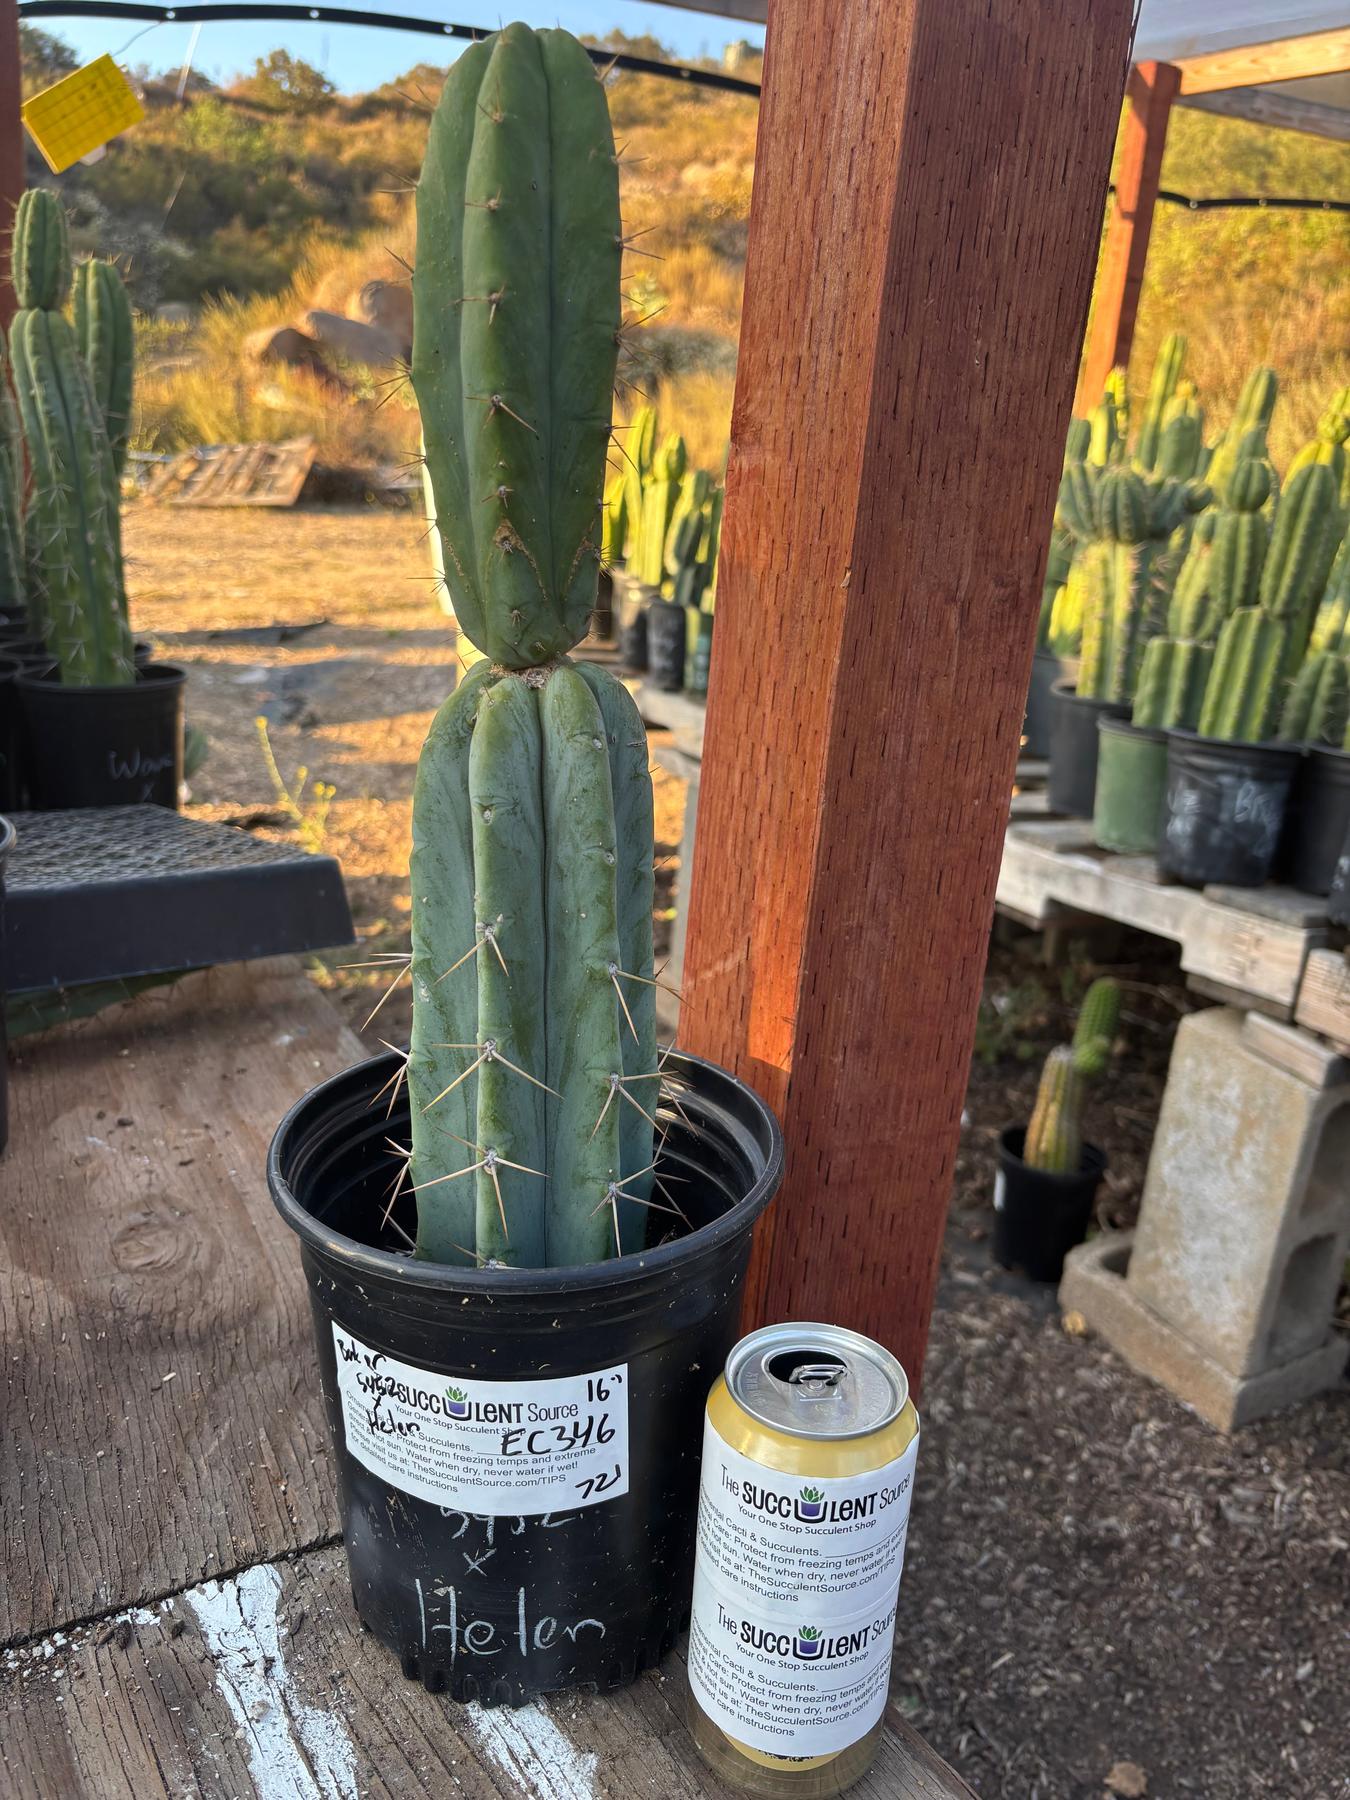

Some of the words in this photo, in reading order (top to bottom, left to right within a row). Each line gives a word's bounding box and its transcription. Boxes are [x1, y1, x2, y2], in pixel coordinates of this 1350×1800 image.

[395, 1404, 412, 1416] Your
[415, 1412, 431, 1424] One
[433, 1417, 453, 1430] Stop
[455, 1421, 500, 1435] Succulent
[502, 1427, 526, 1436] Shp
[528, 1403, 578, 1421] Source
[397, 1434, 430, 1451] Protect
[429, 1447, 450, 1458] from
[453, 1452, 493, 1466] freezing
[497, 1458, 528, 1466] temps
[532, 1456, 551, 1464] and
[554, 1448, 595, 1461] extreme
[419, 1432, 473, 1452] Succulents.
[501, 1414, 615, 1456] EC346
[360, 1442, 386, 1464] detailed
[388, 1460, 405, 1474] care
[407, 1471, 458, 1492] instructions
[372, 1442, 386, 1454] visit
[388, 1451, 397, 1460] us
[399, 1455, 409, 1466] at:
[411, 1460, 566, 1487] TheSucculentSource.com/TIPS
[386, 1441, 403, 1453] sun.
[406, 1448, 432, 1464] Water
[434, 1460, 459, 1471] when
[463, 1466, 481, 1476] dry,
[516, 1468, 545, 1476] water
[548, 1465, 555, 1473] if
[557, 1461, 578, 1472] wet!
[721, 1464, 739, 1496] The
[880, 1473, 910, 1509] Source
[726, 1518, 747, 1537] Cacti
[750, 1533, 757, 1542] &
[760, 1537, 822, 1556] Succulents.
[738, 1503, 756, 1519] Your
[759, 1515, 778, 1528] One
[780, 1522, 802, 1534] Stop
[804, 1526, 852, 1535] Succulent
[855, 1520, 876, 1531] Shop
[712, 1528, 721, 1545] hot
[723, 1541, 739, 1558] sun.
[743, 1553, 771, 1573] Water
[775, 1568, 803, 1579] when
[807, 1572, 826, 1582] dry,
[831, 1568, 859, 1580] never
[861, 1556, 885, 1573] water
[713, 1518, 731, 1540] Care:
[734, 1536, 767, 1559] Protect
[771, 1553, 794, 1565] from
[799, 1559, 842, 1569] freezing
[845, 1552, 874, 1566] temps
[876, 1539, 890, 1555] and
[721, 1566, 738, 1582] care
[740, 1577, 799, 1601] instructions
[722, 1554, 731, 1565] us
[734, 1562, 745, 1573] at:
[748, 1555, 895, 1592] TheSucculentSource.com/TIPS
[415, 1579, 606, 1671] Helen
[718, 1602, 737, 1635] The
[723, 1654, 745, 1674] Cacti
[747, 1670, 754, 1679] &
[757, 1674, 818, 1691] Succulents.
[736, 1641, 754, 1658] Your
[757, 1653, 776, 1666] One
[778, 1660, 800, 1671] Stop
[803, 1660, 848, 1671] Succulent
[849, 1651, 869, 1665] Shop
[707, 1662, 718, 1679] hot
[720, 1676, 737, 1694] sun.
[740, 1689, 769, 1707] Water
[772, 1704, 800, 1713] when
[804, 1707, 822, 1716] dry,
[825, 1700, 852, 1712] never
[854, 1683, 875, 1702] water
[709, 1653, 729, 1676] Care:
[731, 1672, 765, 1695] Protect
[768, 1690, 792, 1701] from
[795, 1694, 836, 1703] freezing
[840, 1682, 865, 1698] temps
[867, 1666, 879, 1683] and
[717, 1698, 735, 1715] care
[737, 1712, 795, 1736] instructions
[719, 1688, 728, 1699] us
[730, 1698, 742, 1708] at:
[744, 1681, 885, 1725] TheSucculentSource.com/TIPS
